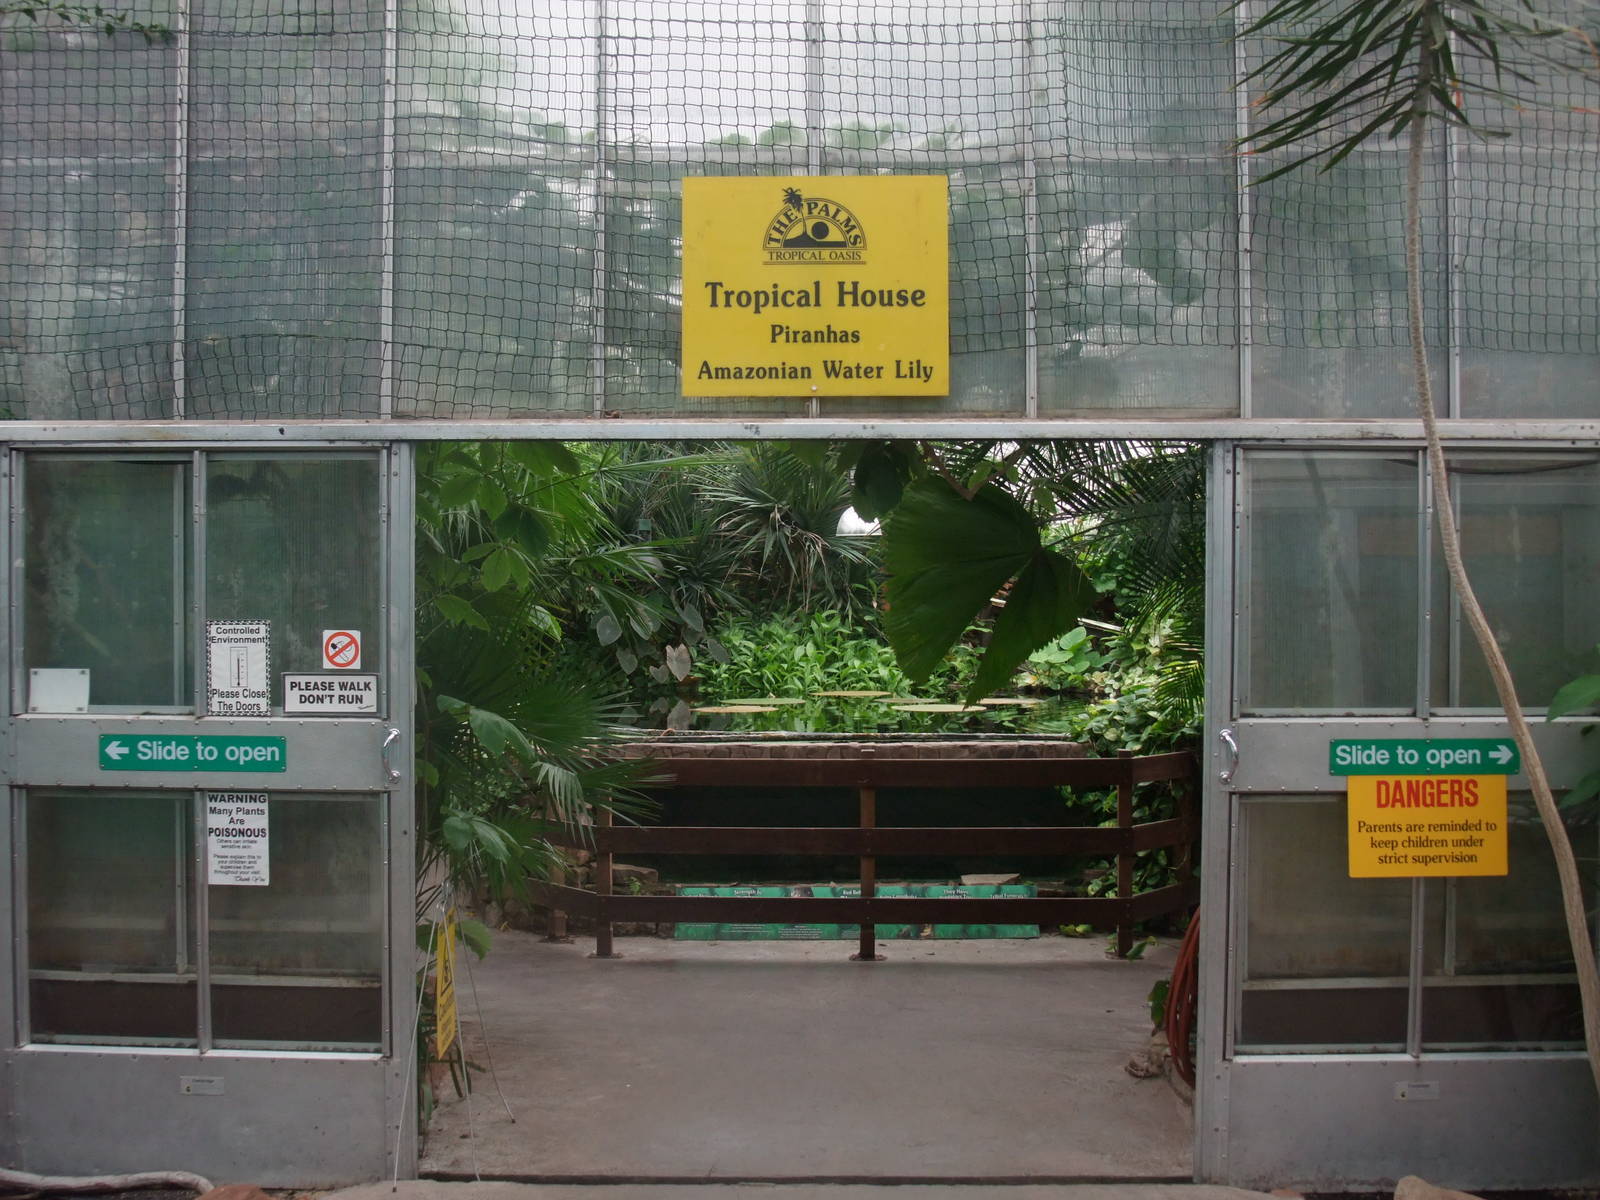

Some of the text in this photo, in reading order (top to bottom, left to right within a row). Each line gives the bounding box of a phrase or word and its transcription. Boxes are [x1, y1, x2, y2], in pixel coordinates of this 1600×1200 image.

[768, 202, 862, 246] THE PALMS
[768, 251, 862, 260] TROPICAL OASIS
[704, 281, 926, 314] Tropical House
[770, 324, 860, 343] Piranhas
[698, 360, 934, 382] Amazonian Water Lily
[216, 626, 260, 634] Controlled
[290, 681, 372, 692] PLEASE WALK
[212, 688, 266, 698] Please Close
[299, 694, 364, 704] DON'T RUN
[218, 701, 261, 711] The Doors
[137, 740, 280, 765] Slide to open
[1336, 745, 1481, 768] Slide to open
[1376, 778, 1479, 808] DANGERS
[208, 794, 267, 804] WARNING
[209, 806, 266, 817] Many Plants
[228, 816, 246, 824] Are
[1357, 820, 1498, 832] Parents are reminded to
[208, 828, 267, 838] POISONOUS
[1370, 836, 1485, 851] keep children under
[1378, 852, 1478, 866] strict supervision
